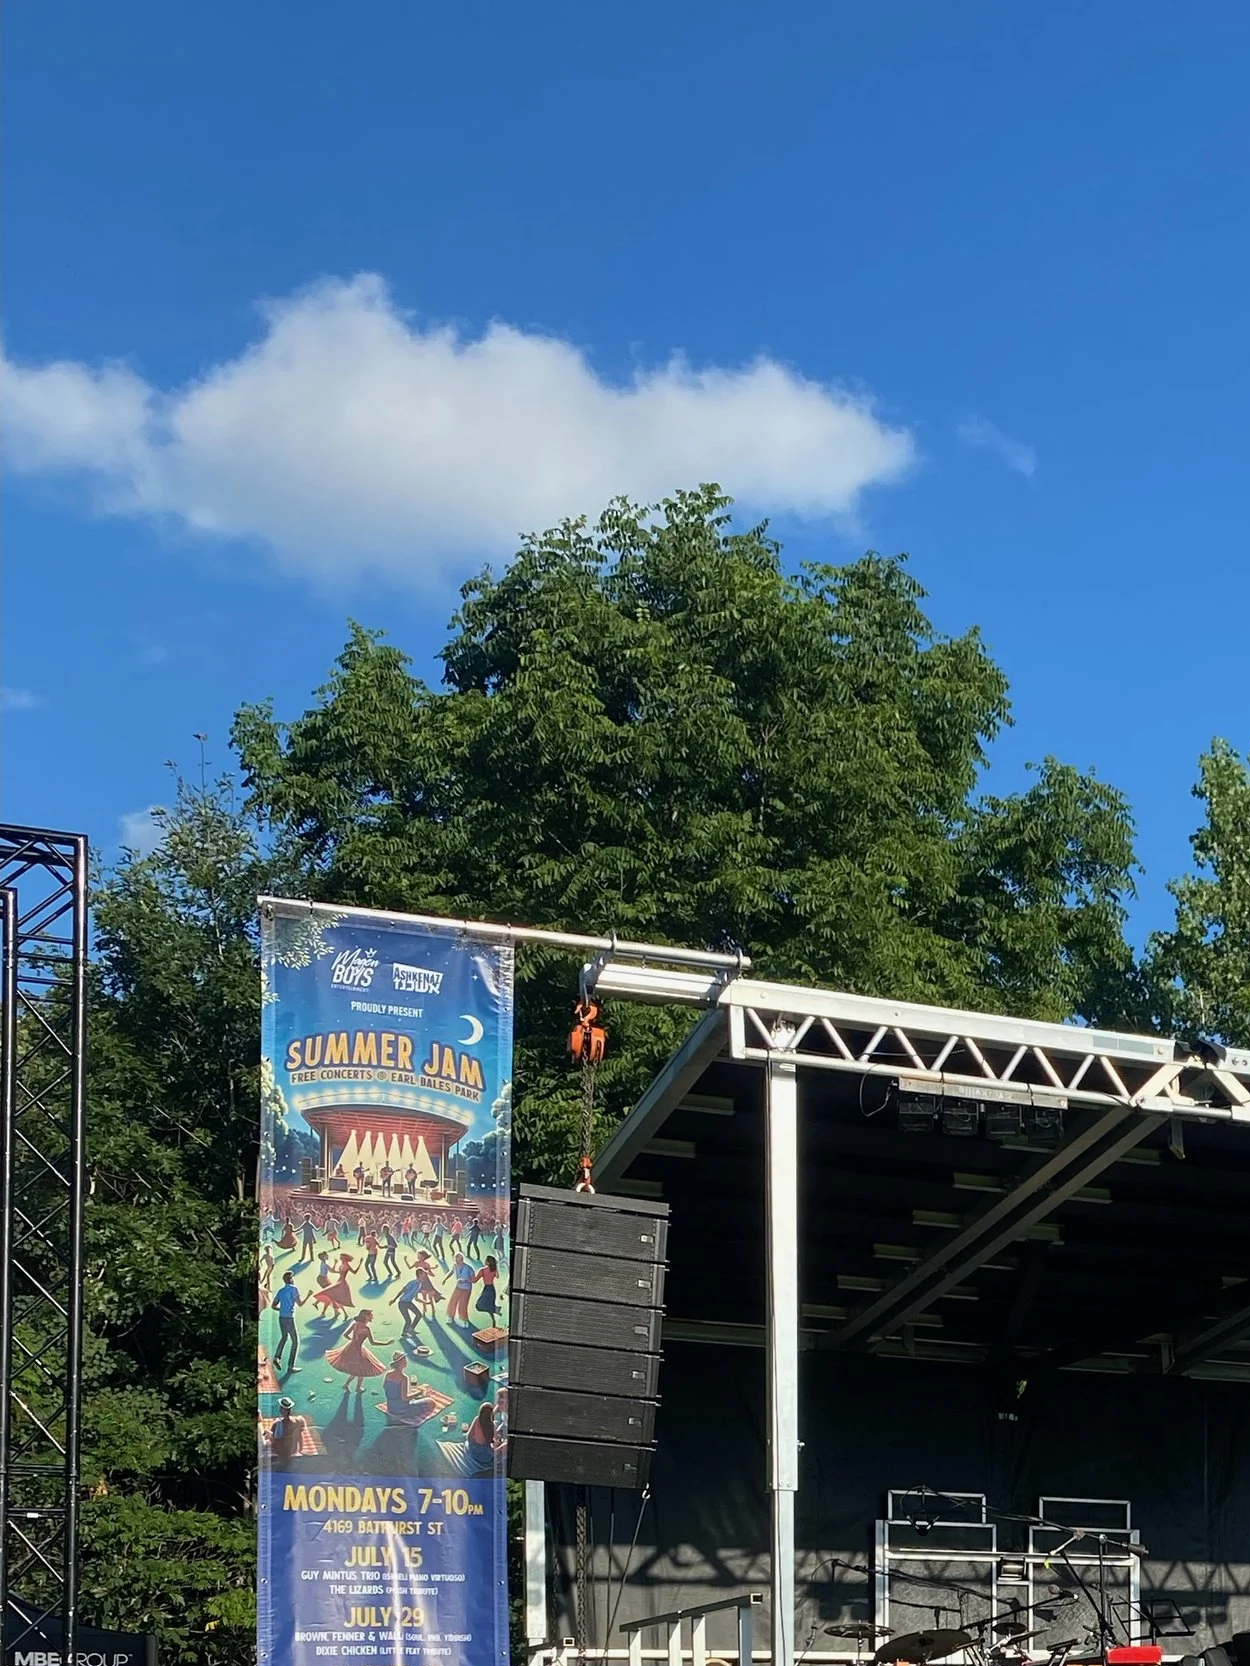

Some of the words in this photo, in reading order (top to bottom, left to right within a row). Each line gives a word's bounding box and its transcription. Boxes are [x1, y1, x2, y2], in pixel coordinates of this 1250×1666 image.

[333, 964, 374, 987] BOYS
[350, 1001, 387, 1014] PROUDLY
[388, 1005, 424, 1018] PRESENT
[286, 1031, 413, 1070] SUMMER
[423, 1042, 484, 1089] JAM
[291, 1069, 316, 1083] FREE
[320, 1069, 373, 1080] CONCERTS
[391, 1072, 416, 1085] EARL
[454, 1085, 480, 1101] PARK
[283, 1485, 408, 1514] MONDAYS
[323, 1519, 352, 1533] 4169
[427, 1522, 444, 1535] ST
[344, 1546, 393, 1567] JULY
[403, 1548, 423, 1568] 15
[301, 1571, 319, 1581] GUY
[322, 1571, 357, 1581] MINTUS
[360, 1571, 380, 1581] TRIO
[329, 1585, 346, 1595] THE
[349, 1585, 383, 1595] LIZARDS
[343, 1607, 393, 1628] JULY
[401, 1607, 425, 1628] 29
[332, 1631, 366, 1641] FENNER
[368, 1631, 376, 1642] &
[316, 1646, 338, 1656] DIXIE
[341, 1645, 378, 1655] CHICKEN
[405, 1647, 421, 1655] FEAT
